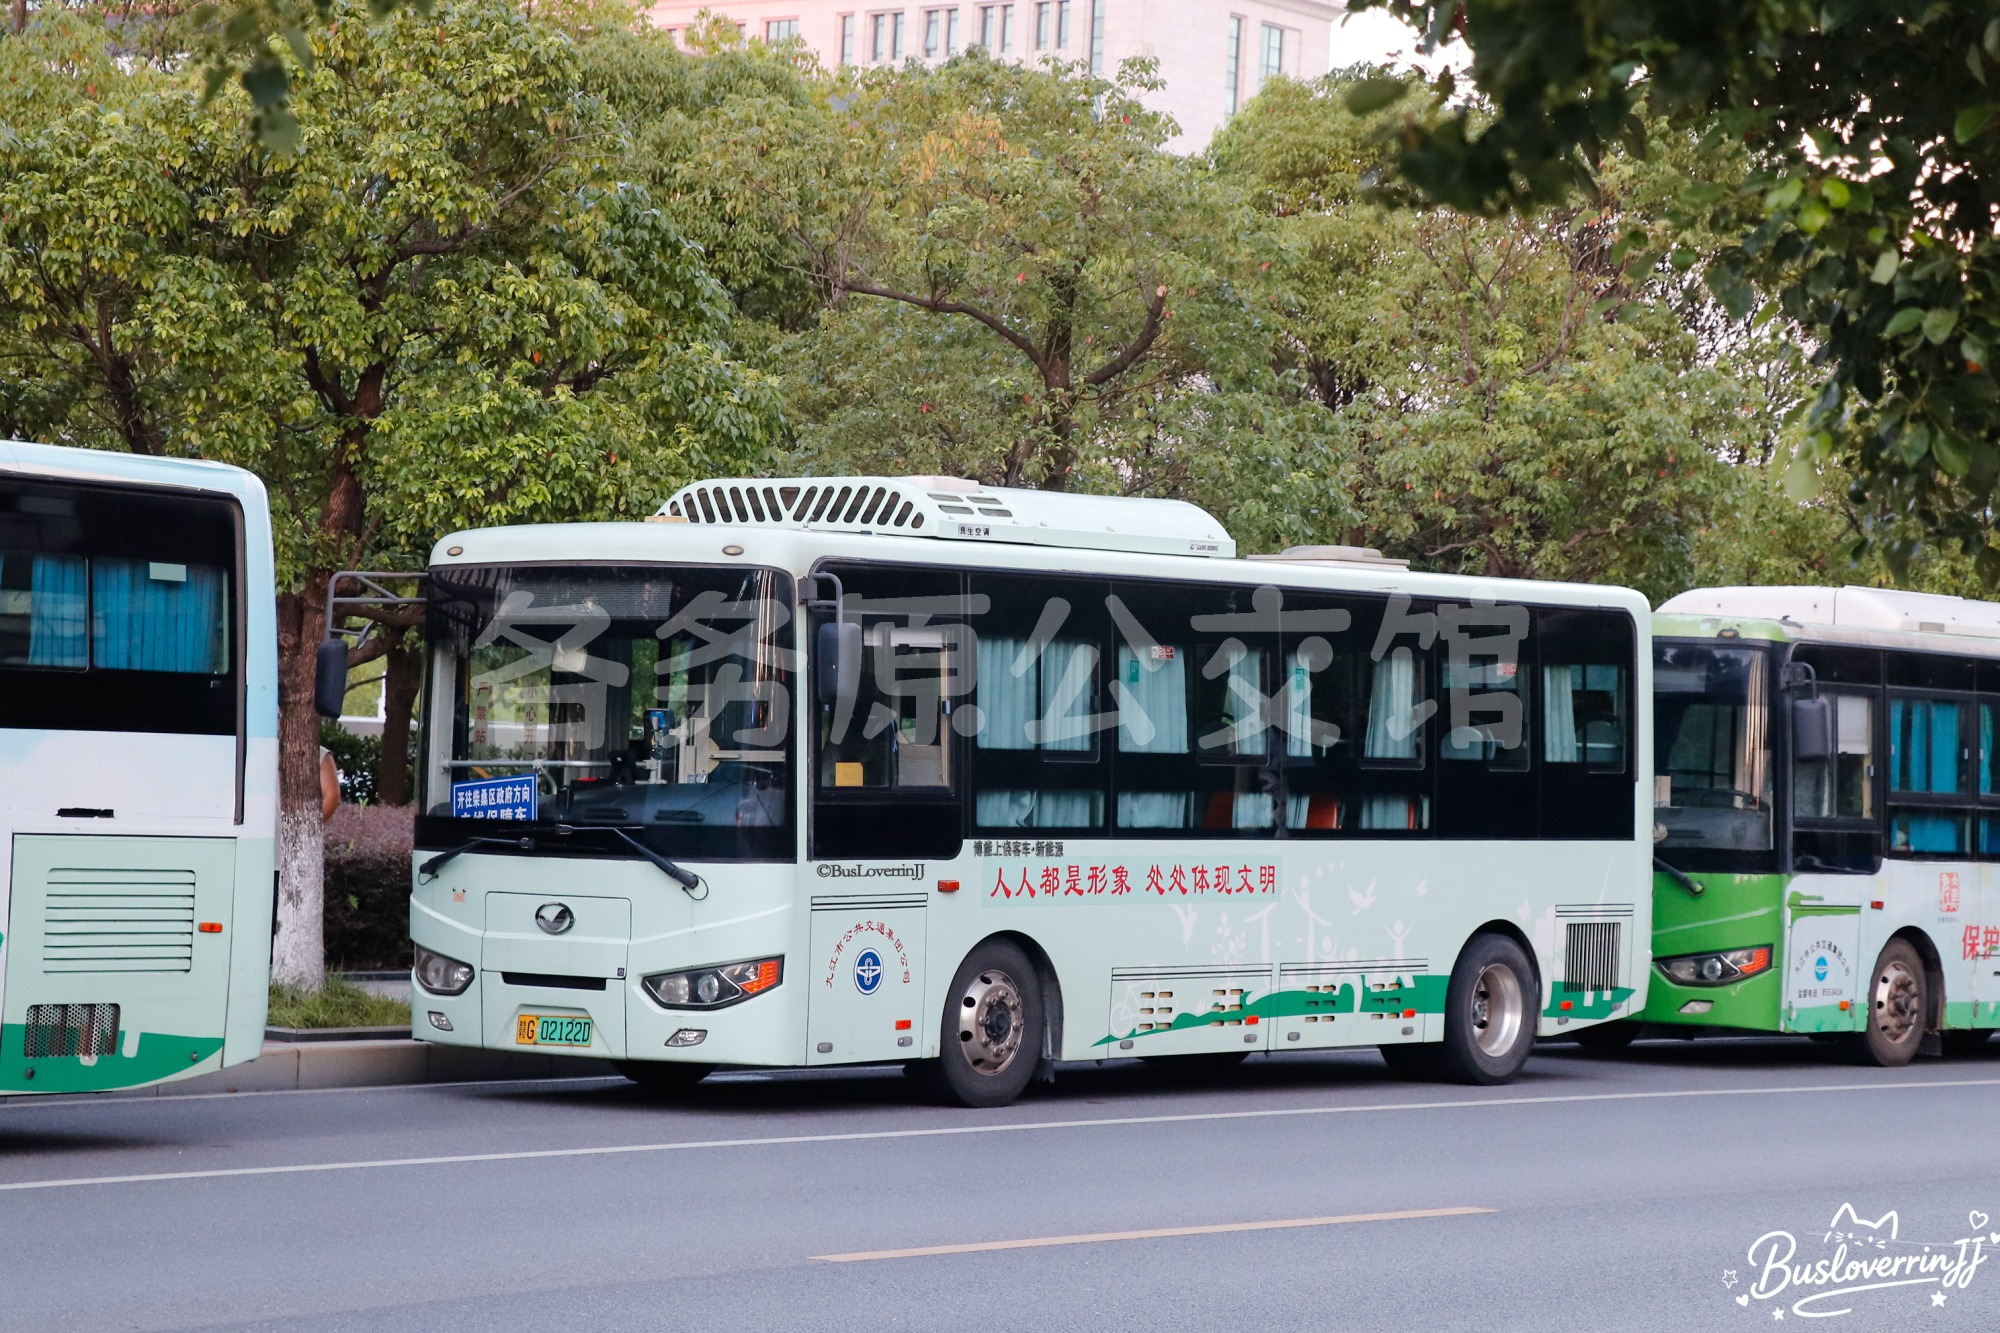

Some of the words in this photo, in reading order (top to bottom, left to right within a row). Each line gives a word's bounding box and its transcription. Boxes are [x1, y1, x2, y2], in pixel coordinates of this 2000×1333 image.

[457, 784, 530, 809] 开往柴桑区政府方向
[990, 864, 1131, 899] 人人都是形象
[1145, 863, 1276, 896] 处处体现文明
[826, 920, 910, 989] 九江市公共交通集团公司
